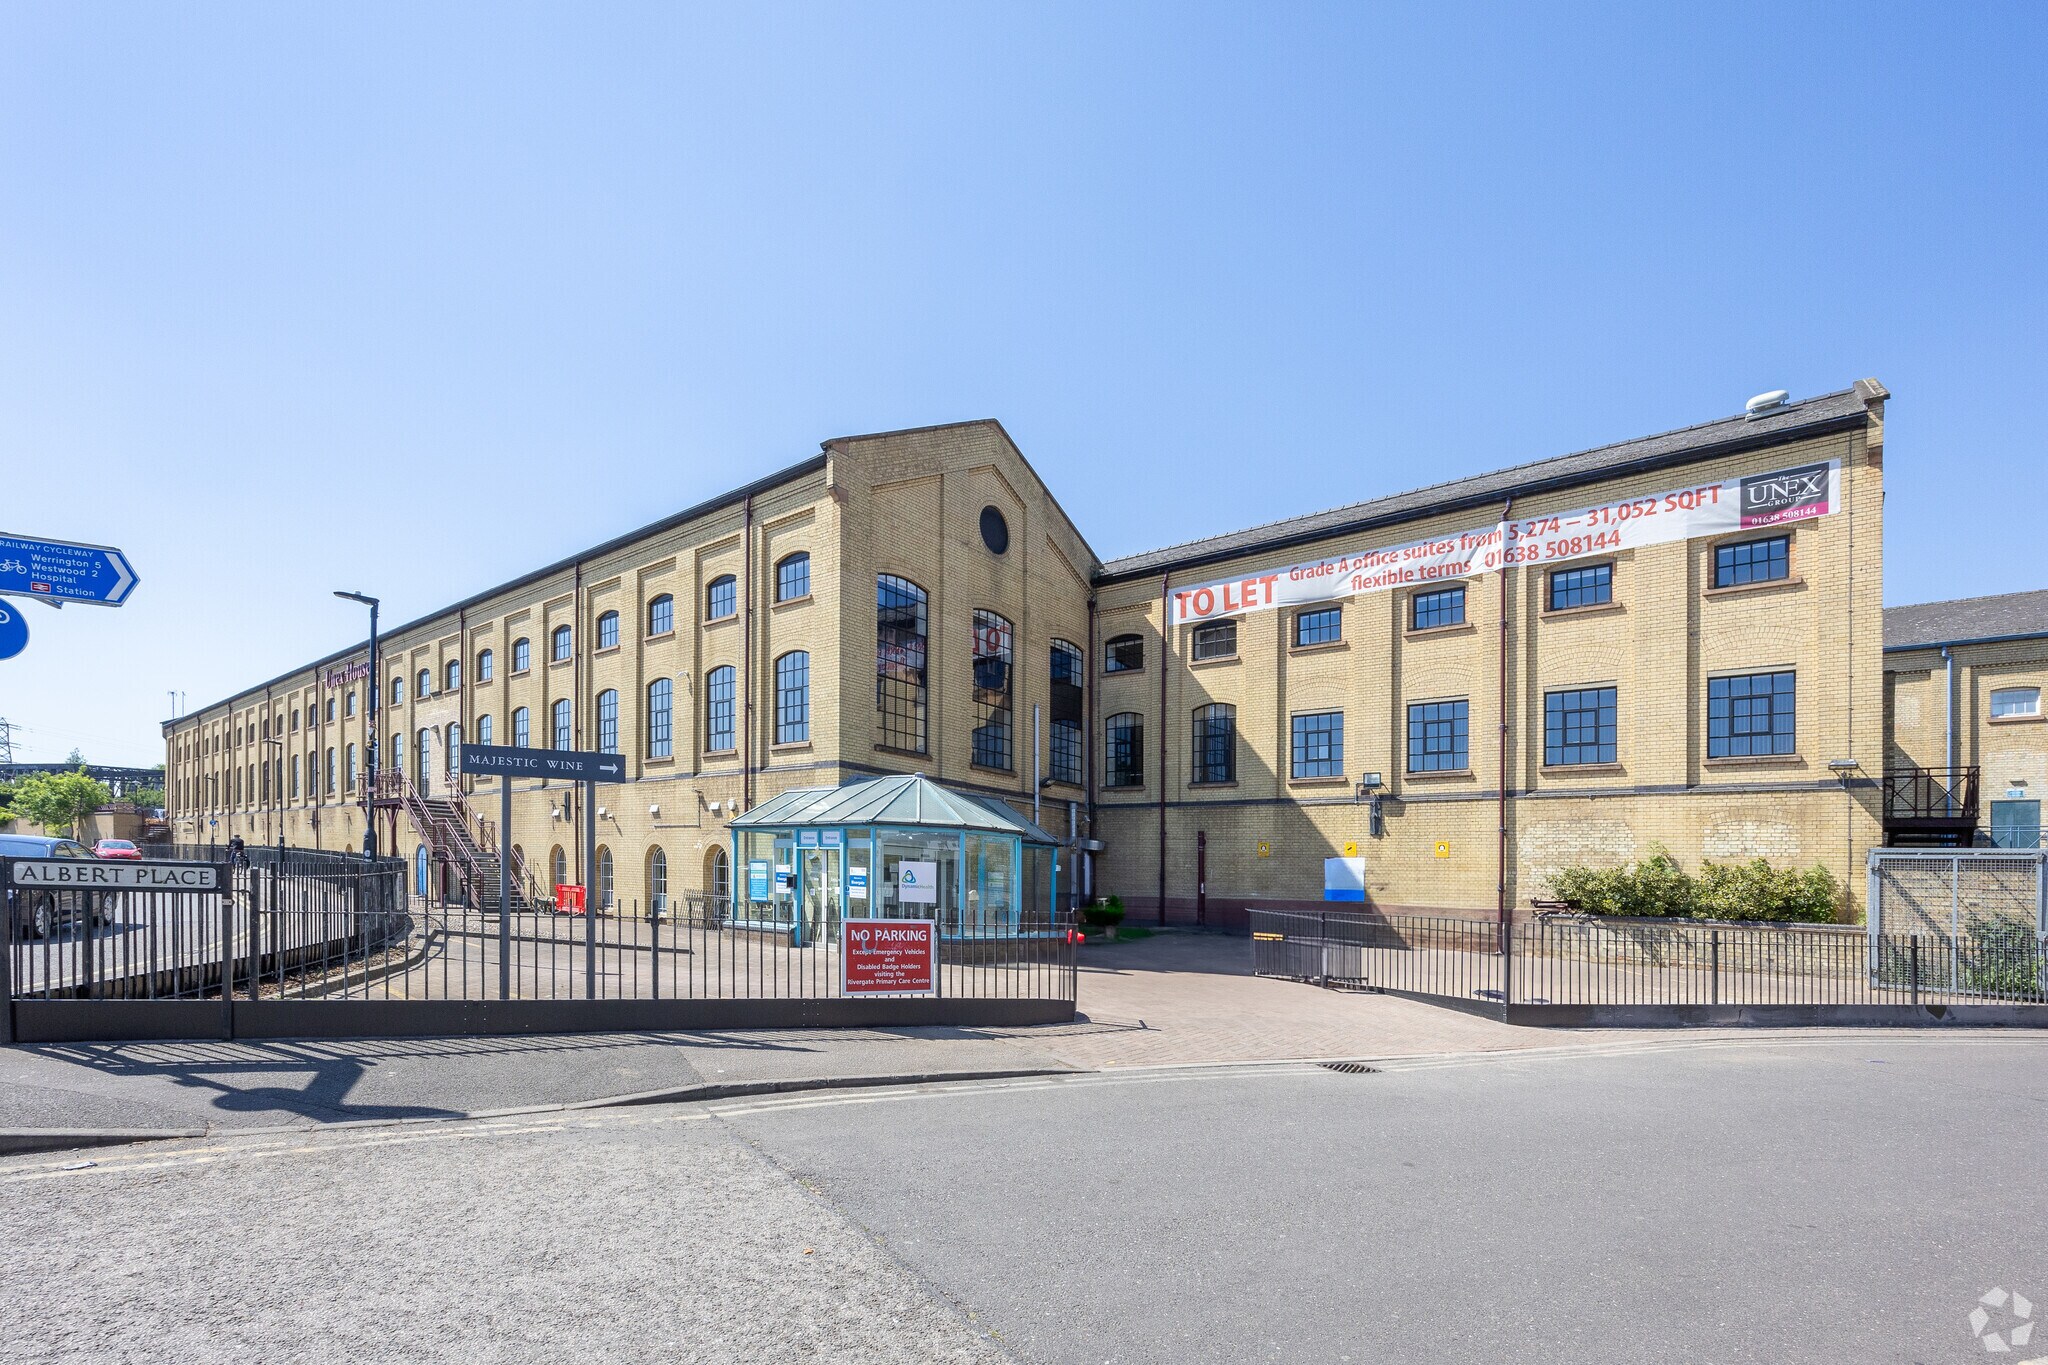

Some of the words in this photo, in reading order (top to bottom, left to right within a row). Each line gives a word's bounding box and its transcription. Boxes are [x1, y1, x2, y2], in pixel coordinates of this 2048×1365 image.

[1747, 475, 1821, 503] UNEX
[1767, 496, 1801, 507] GROUP
[1751, 514, 1780, 525] 01638
[1782, 506, 1817, 520] 508144
[1289, 561, 1334, 582] Grade
[1338, 557, 1349, 573] A
[1353, 550, 1399, 570] office
[1403, 540, 1455, 561] suites
[1460, 530, 1502, 551] from
[1508, 516, 1560, 542] 5,274
[1587, 498, 1658, 527] 31,052
[1664, 484, 1722, 512] SQFT
[0, 540, 41, 551] RAILWAY
[43, 545, 94, 558] CYCLEWAY
[31, 553, 89, 568] Werrington
[94, 561, 102, 569] 5
[1351, 568, 1414, 591] flexible
[1419, 560, 1471, 580] terms
[1485, 544, 1539, 568] 01638
[1545, 529, 1621, 559] 508144
[31, 562, 86, 576] Westwood
[91, 570, 99, 578] 2
[31, 572, 77, 584] Hospital
[56, 585, 95, 597] Station
[1174, 588, 1215, 618] TO
[1223, 574, 1278, 612] LET
[469, 754, 538, 768] MAJESTIC
[546, 759, 584, 771] WINE
[20, 865, 124, 883] ALBERT
[136, 869, 210, 886] PLACE
[851, 929, 870, 941] NO
[875, 929, 927, 941] PARKING
[873, 949, 903, 957] Emergency
